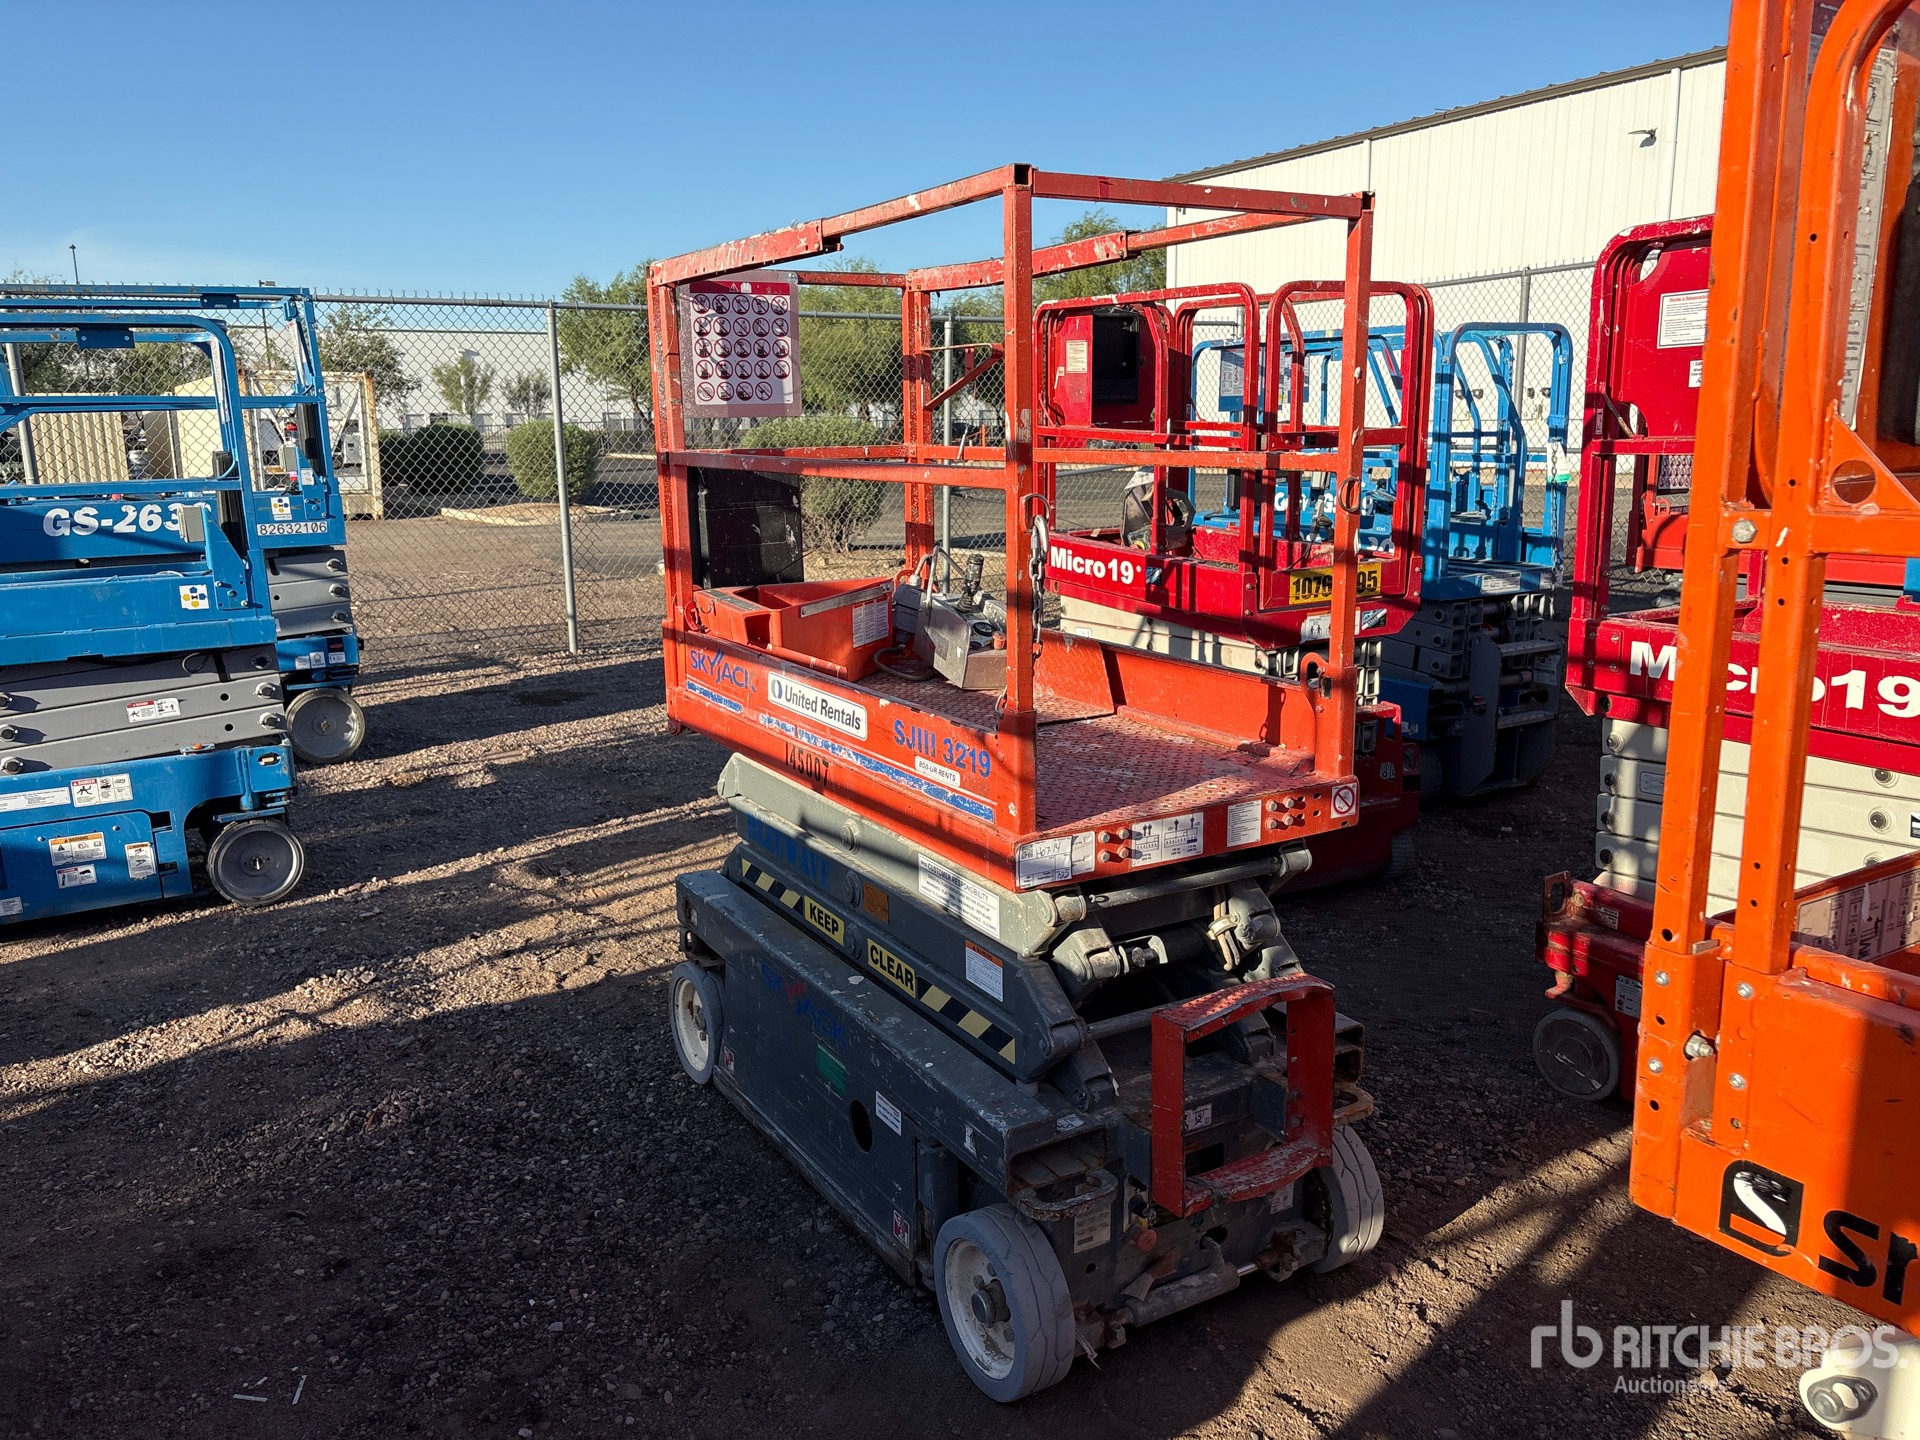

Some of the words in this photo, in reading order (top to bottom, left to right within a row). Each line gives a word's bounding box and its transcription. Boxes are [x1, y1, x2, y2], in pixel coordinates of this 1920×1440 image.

[42, 502, 211, 537] GS-263
[259, 521, 327, 536] 82632106
[1292, 570, 1378, 600] 107695
[784, 684, 818, 714] United
[819, 698, 862, 731] Rentals
[893, 719, 937, 758] SJIII
[942, 737, 991, 778] 3219
[927, 862, 951, 882] CUSTOMER
[951, 875, 988, 903] RESPONSIBILITY
[809, 902, 839, 936] KEEP
[870, 944, 915, 992] CLEAR
